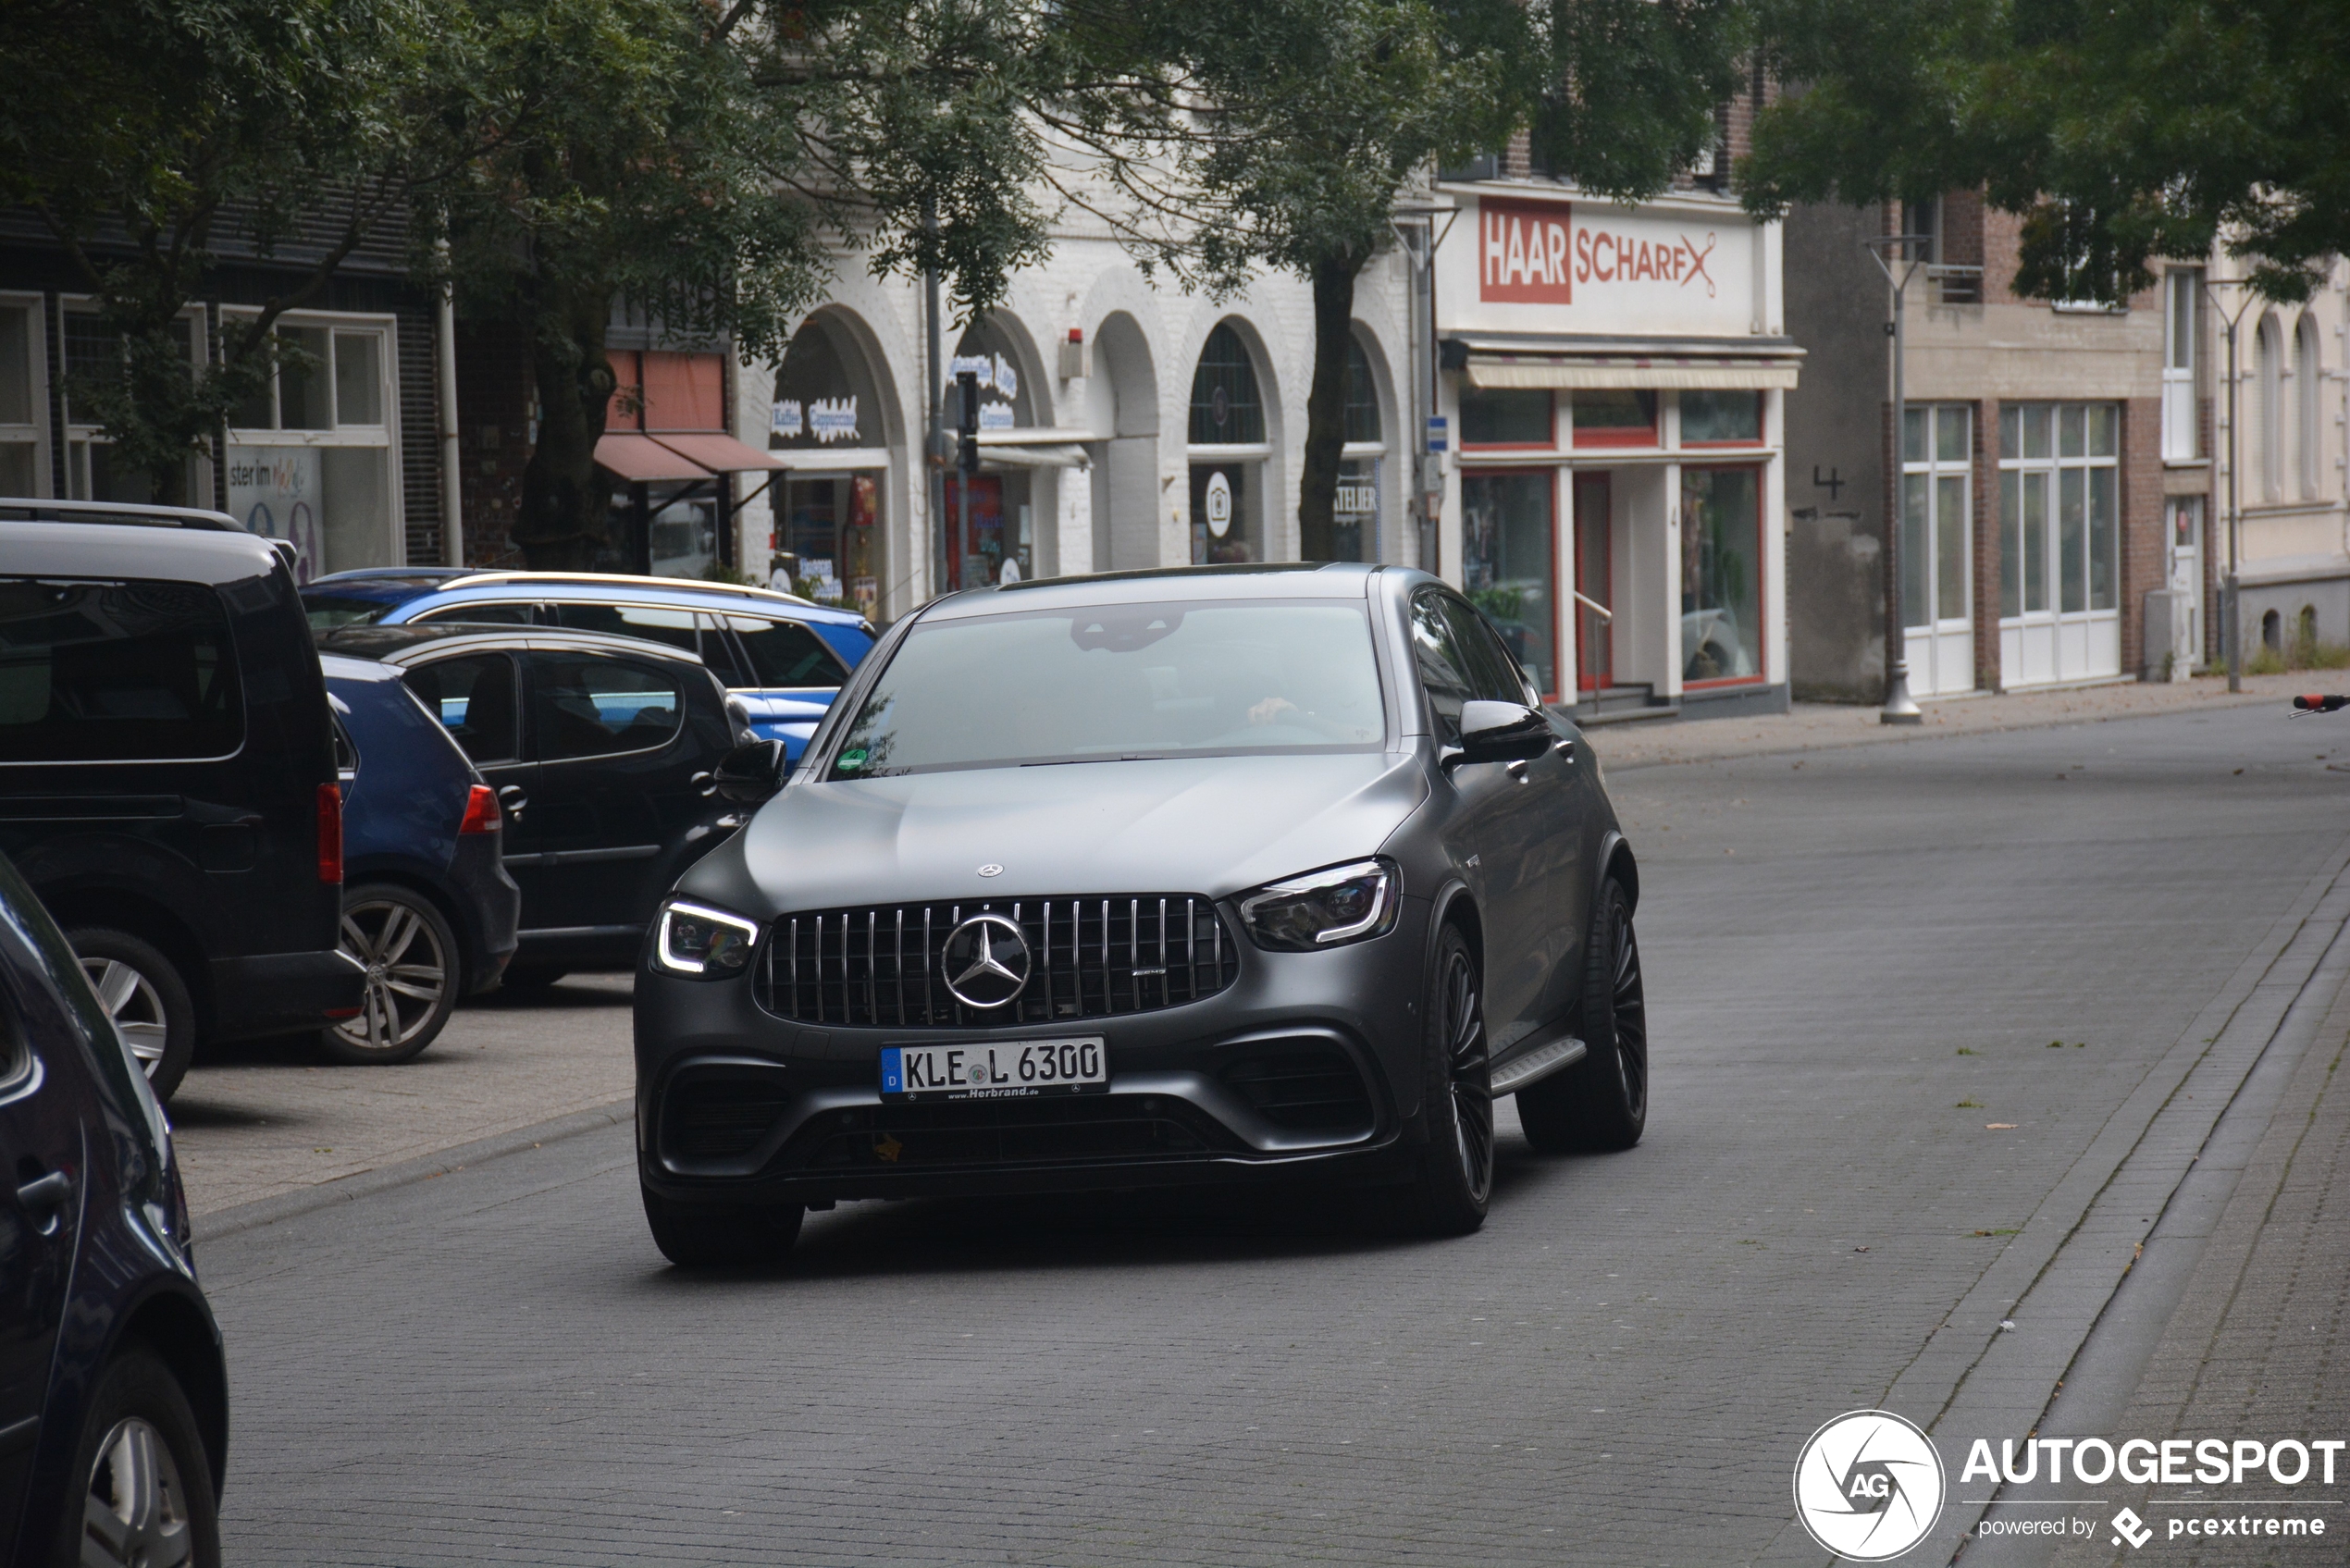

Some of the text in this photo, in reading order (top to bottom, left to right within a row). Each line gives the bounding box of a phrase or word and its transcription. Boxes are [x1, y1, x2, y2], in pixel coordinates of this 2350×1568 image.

[1486, 211, 1687, 285] HAAR SCHARF
[774, 408, 856, 431] Kaffee Cappuccino
[255, 458, 271, 487] im
[1814, 464, 1846, 500] 4
[906, 1043, 1099, 1088] KLE L 6300
[888, 1076, 897, 1086] D
[948, 1086, 1039, 1100] www.Herbrand.de
